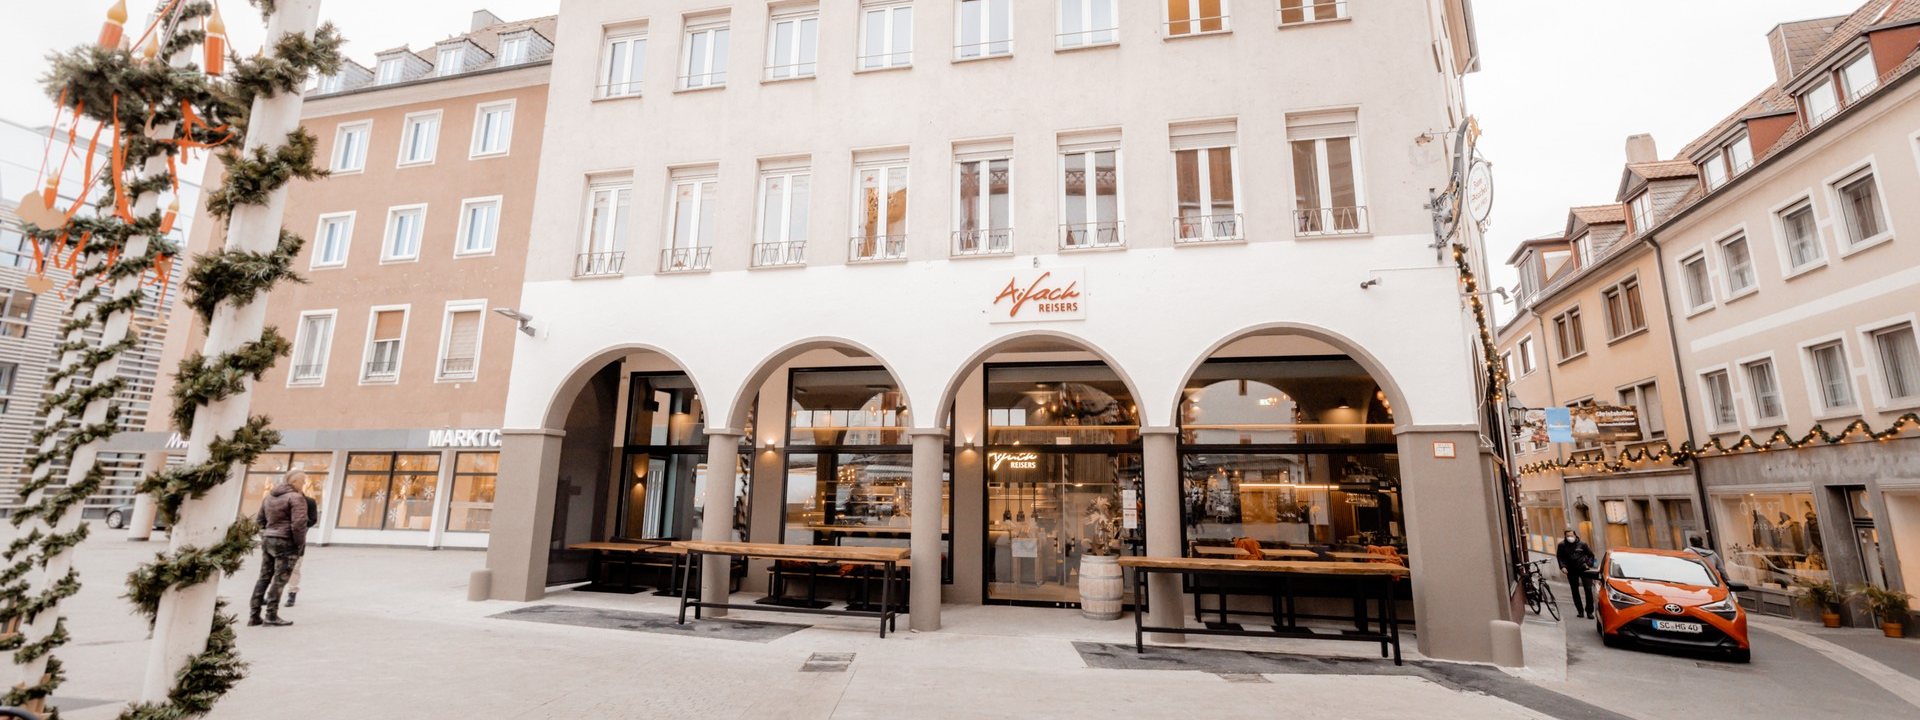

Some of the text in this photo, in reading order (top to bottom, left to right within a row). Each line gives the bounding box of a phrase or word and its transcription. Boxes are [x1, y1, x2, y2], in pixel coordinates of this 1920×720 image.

[993, 271, 1080, 318] Aifach
[1038, 302, 1078, 313] REISERS
[428, 428, 503, 448] MARKTC
[1010, 461, 1037, 469] REISERS
